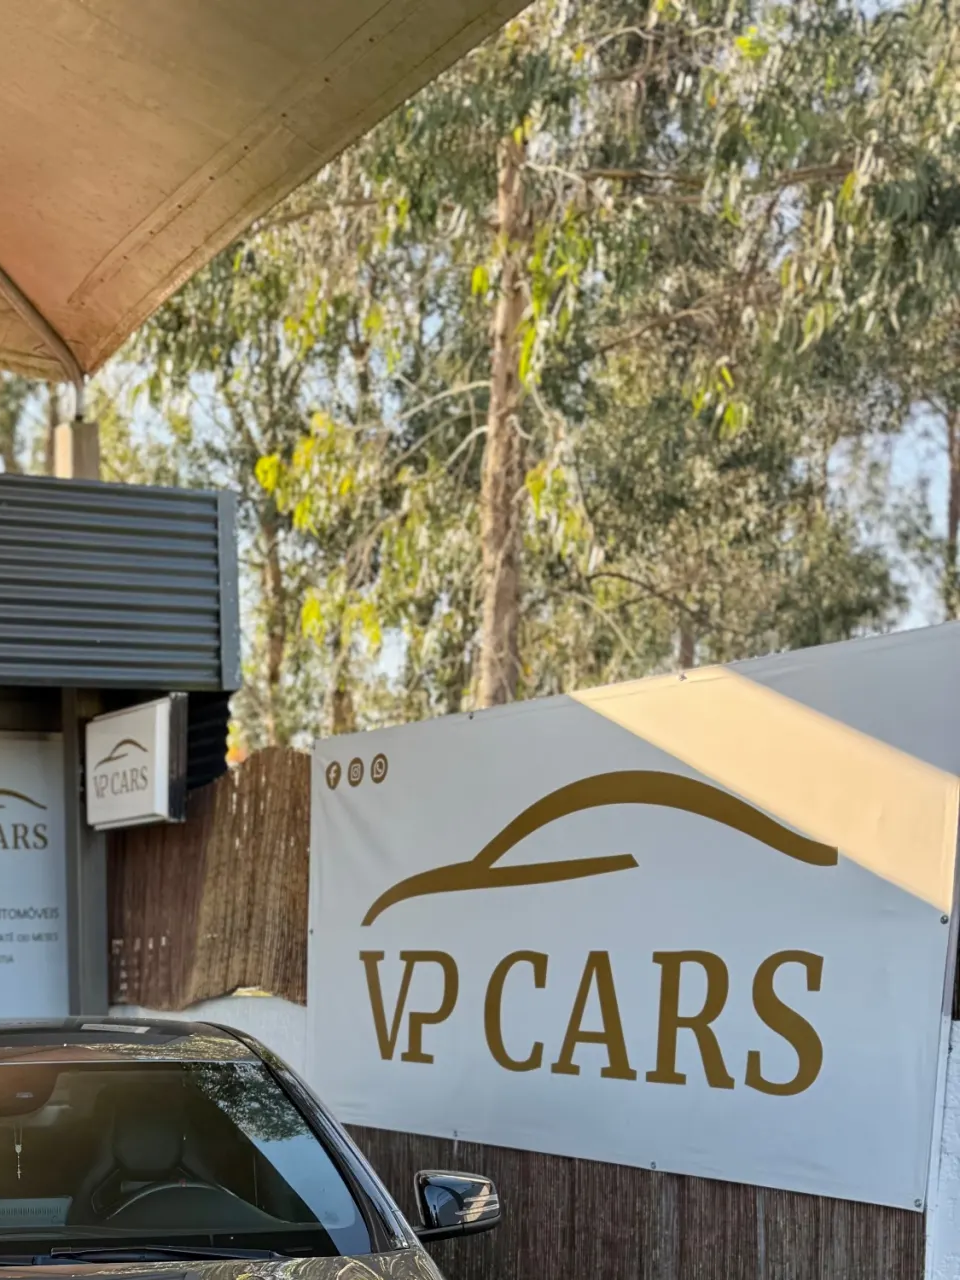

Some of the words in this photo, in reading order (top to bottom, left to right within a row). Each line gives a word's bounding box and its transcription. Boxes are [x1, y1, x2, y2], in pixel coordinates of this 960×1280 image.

[93, 774, 108, 799] VP
[110, 765, 148, 796] CARS
[359, 950, 459, 1064] VP
[484, 950, 825, 1096] CARS
